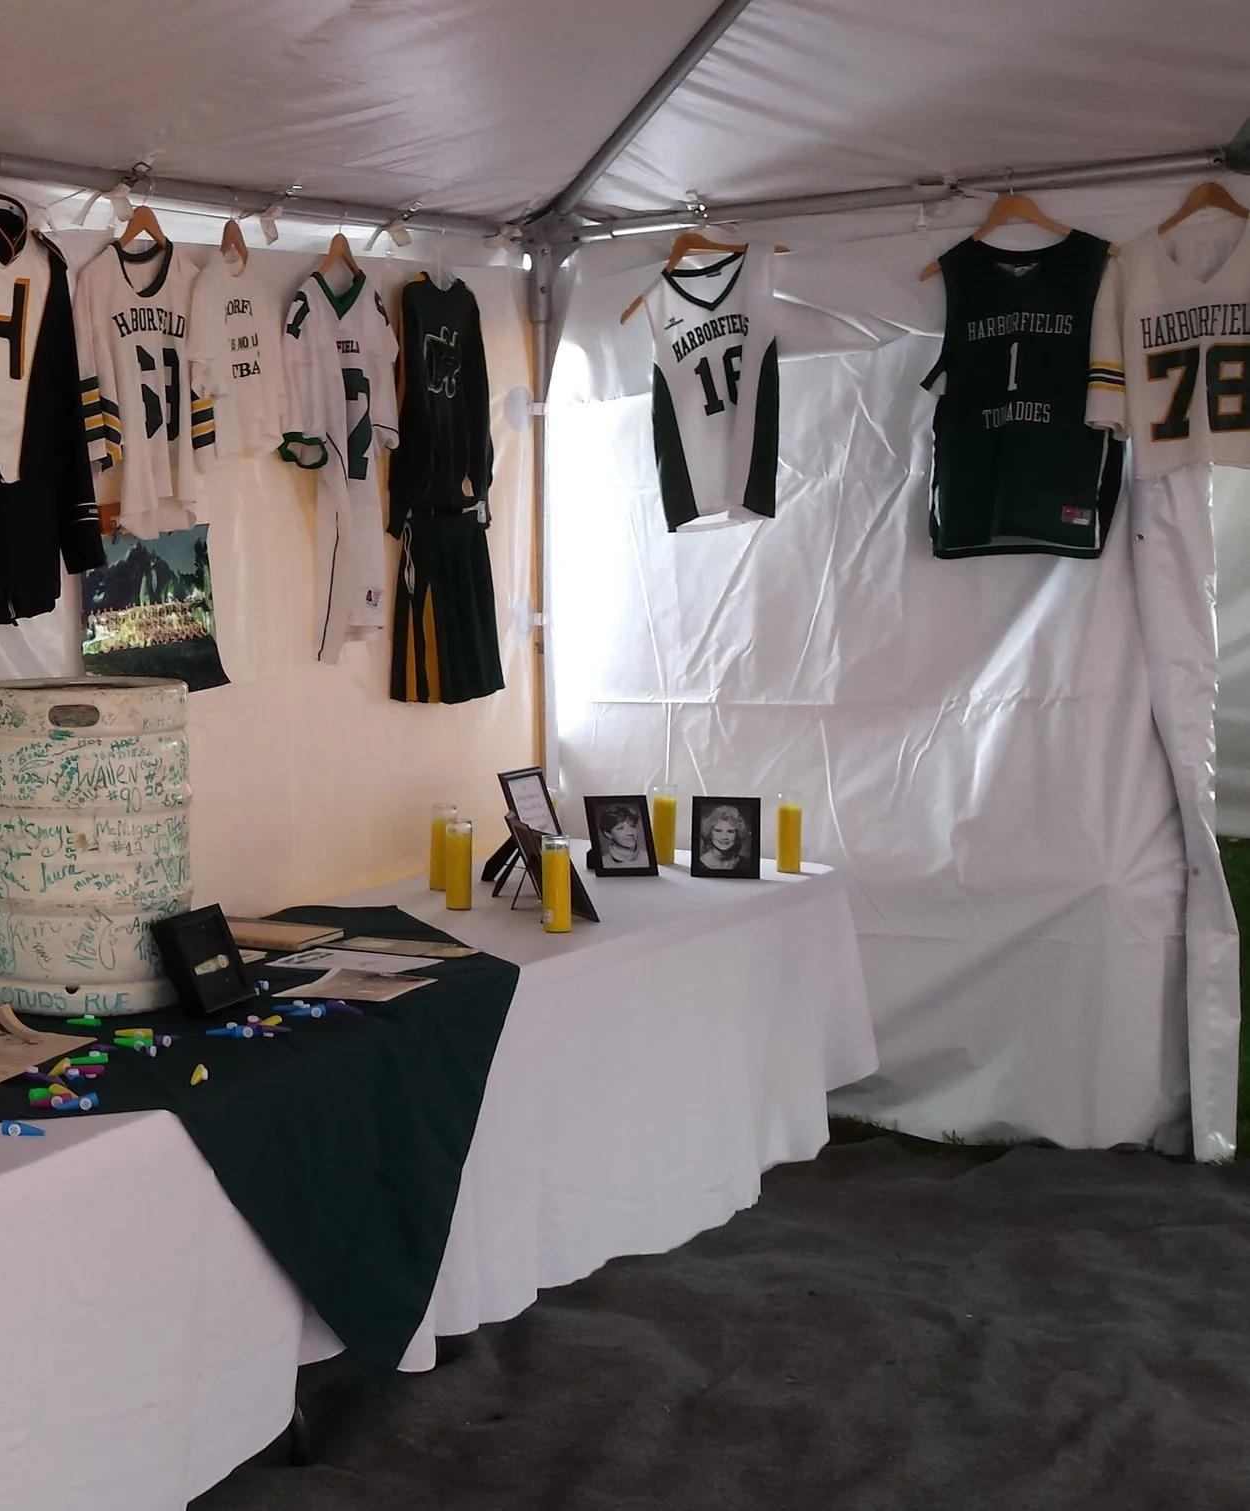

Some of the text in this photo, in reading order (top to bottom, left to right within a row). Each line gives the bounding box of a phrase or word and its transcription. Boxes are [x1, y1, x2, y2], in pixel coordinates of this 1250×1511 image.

[967, 311, 1074, 342] HARBORFIELDS
[1007, 341, 1020, 392] 1
[1145, 341, 1250, 443] 78
